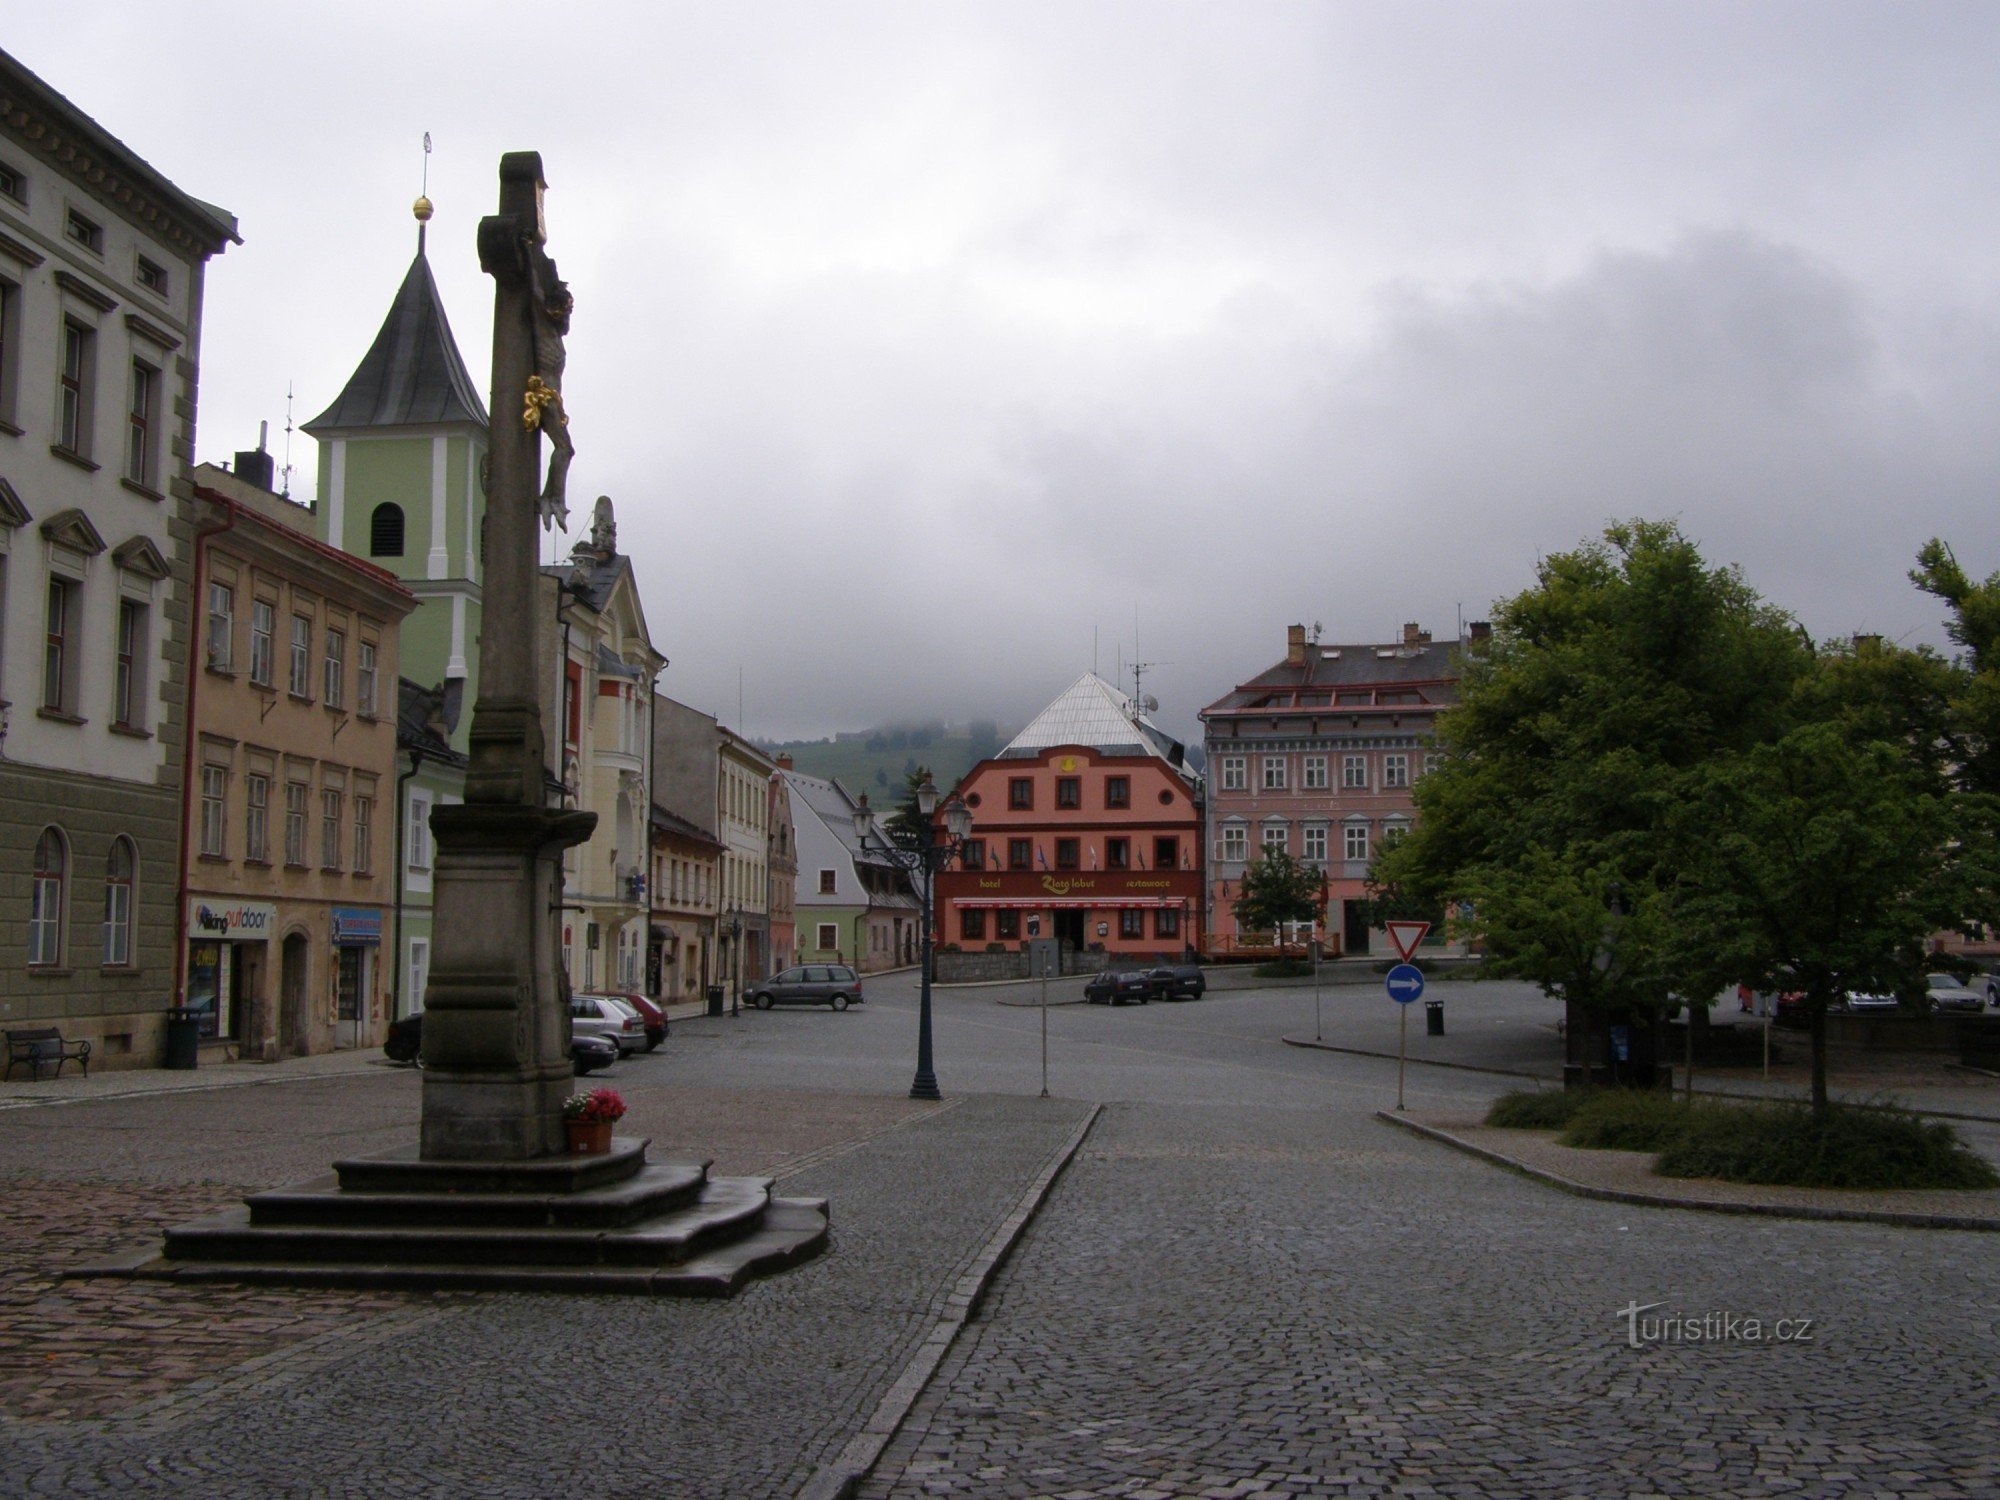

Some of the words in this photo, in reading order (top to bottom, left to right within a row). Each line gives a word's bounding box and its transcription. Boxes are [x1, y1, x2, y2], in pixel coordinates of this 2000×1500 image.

[979, 878, 1001, 888] hotel
[1126, 879, 1171, 888] restaurace
[226, 906, 266, 929] outdoor
